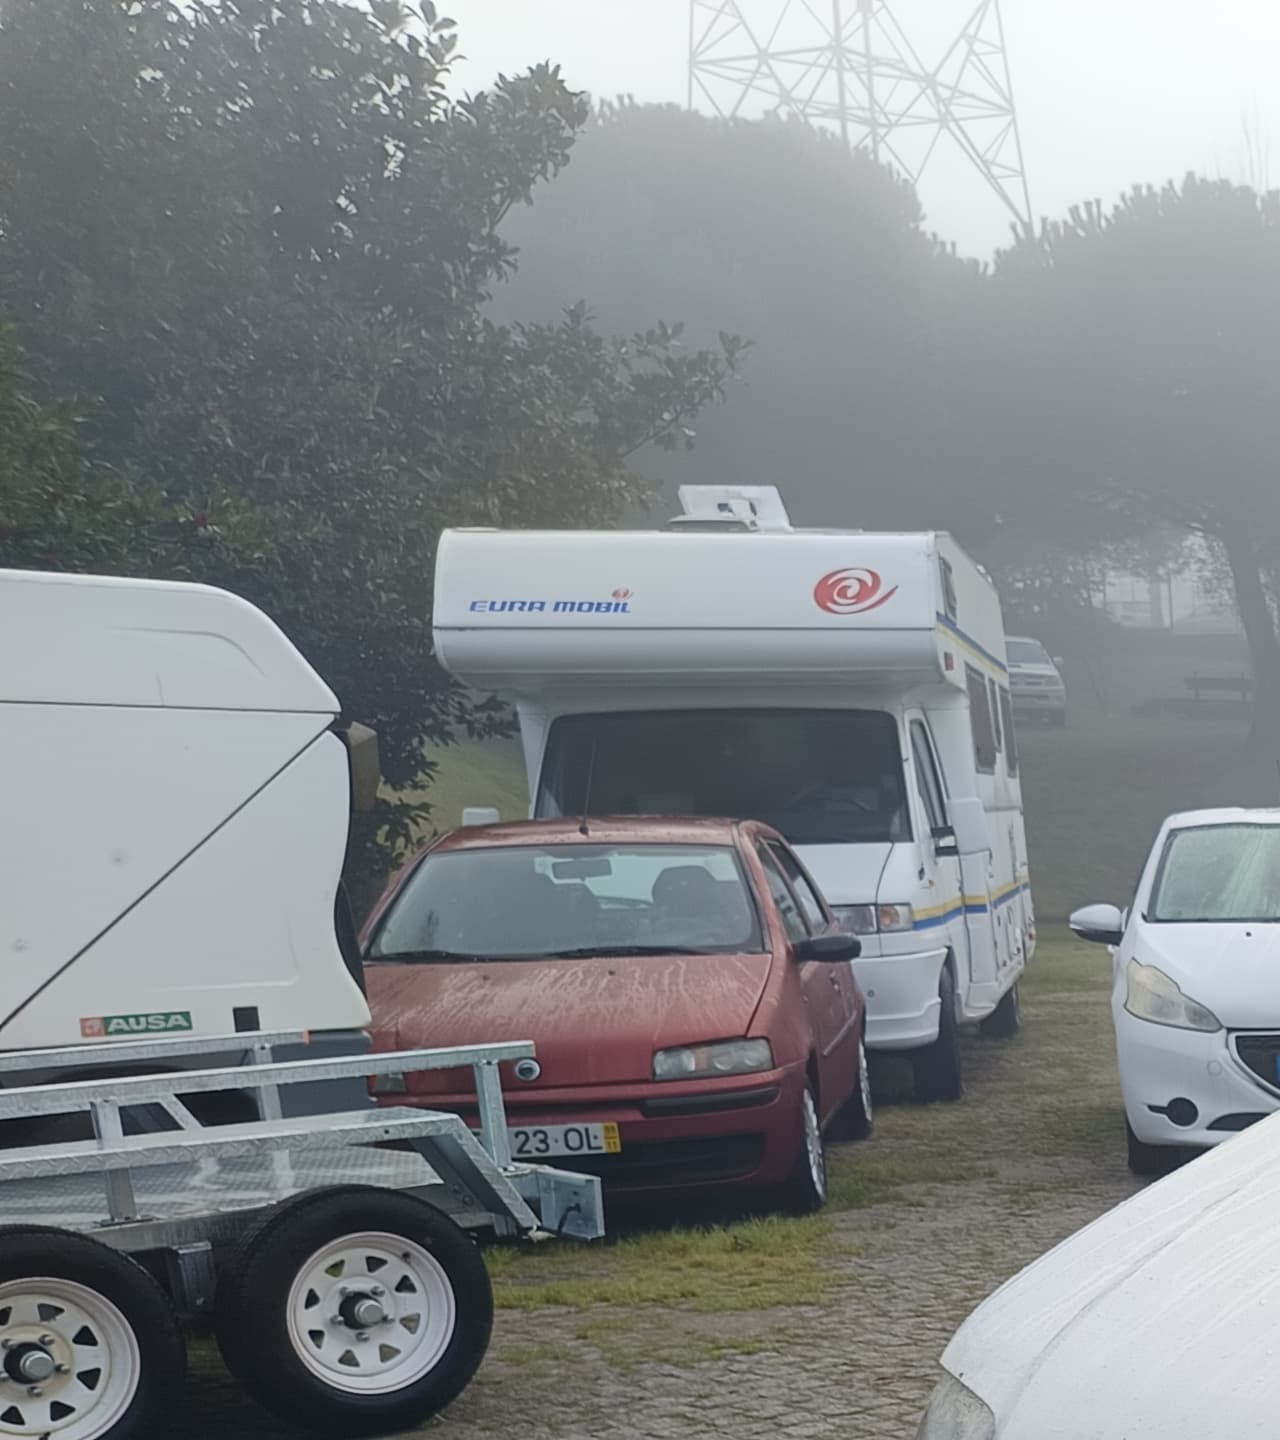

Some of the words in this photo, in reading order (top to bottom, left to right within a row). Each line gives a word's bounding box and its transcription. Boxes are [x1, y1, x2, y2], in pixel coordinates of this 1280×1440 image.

[469, 600, 546, 613] EURA
[552, 600, 632, 614] MOBIL
[107, 1014, 190, 1033] AUSA
